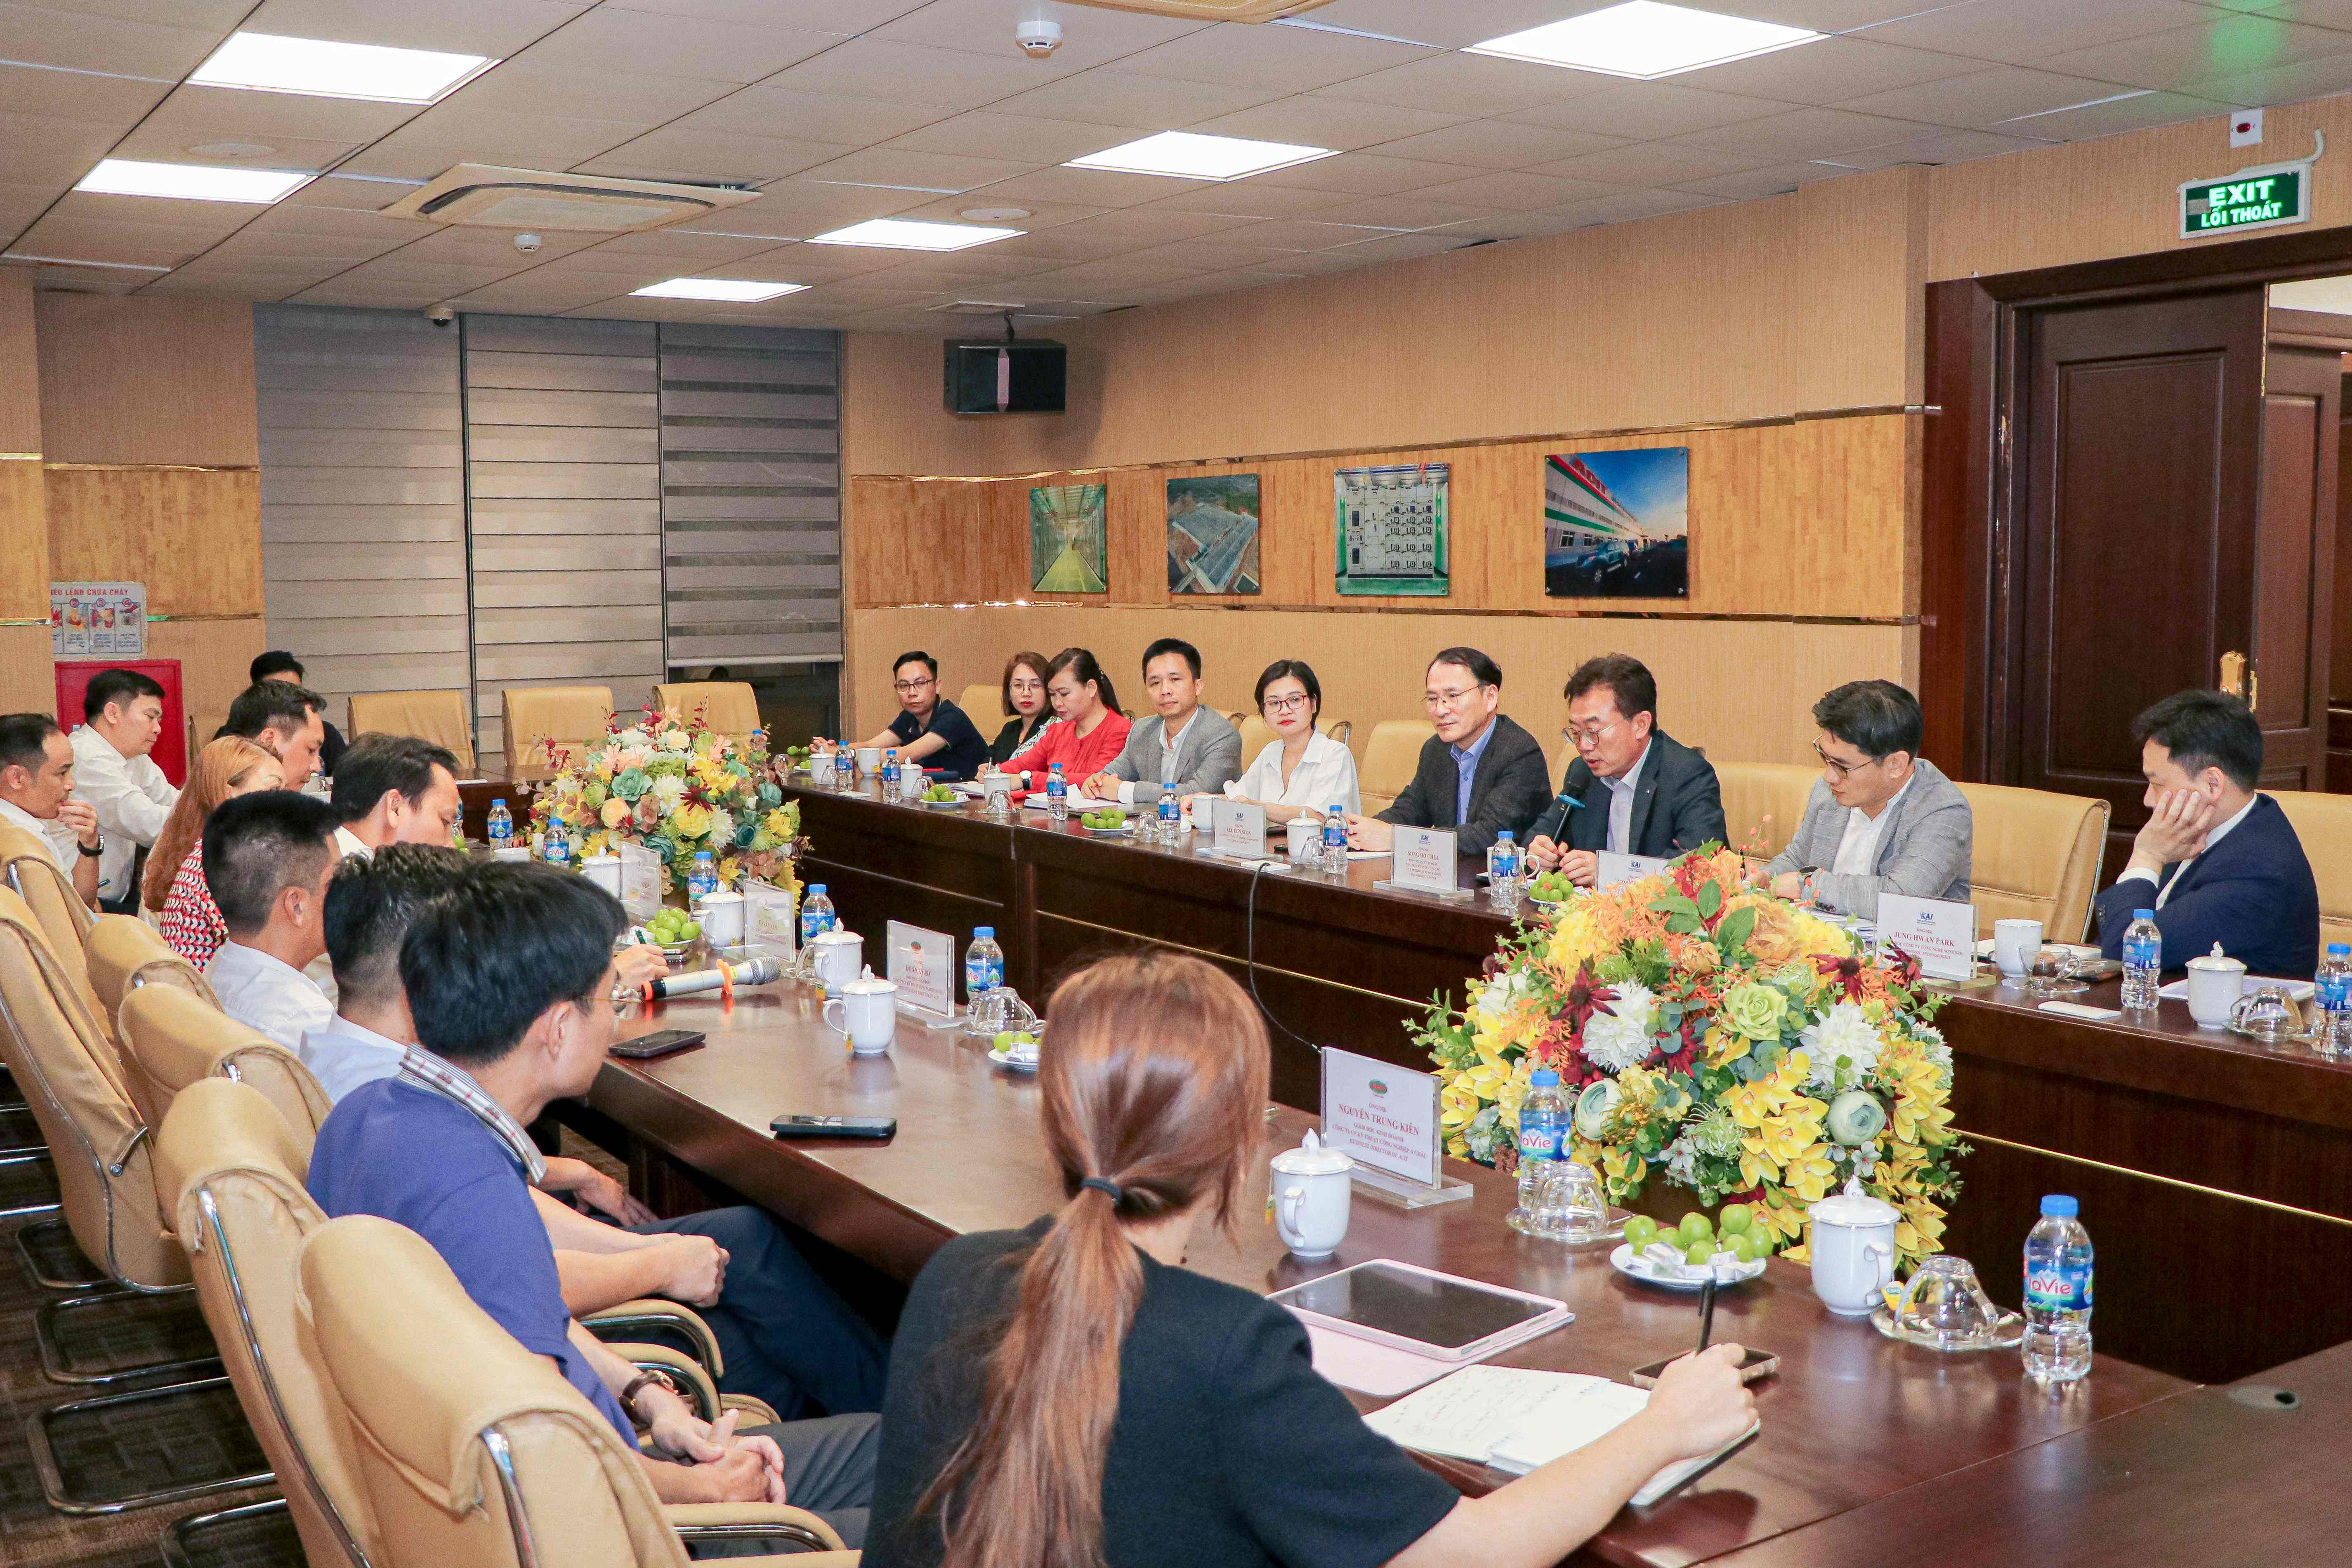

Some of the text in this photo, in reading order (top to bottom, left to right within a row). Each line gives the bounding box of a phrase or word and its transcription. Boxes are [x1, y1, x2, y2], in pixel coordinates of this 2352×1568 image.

[2209, 179, 2275, 207] EXIT
[2201, 200, 2282, 227] LỐI THOÁT
[1894, 931, 1954, 947] JUNG HWAN PARK
[1372, 1113, 1400, 1129] TRUNG
[1400, 1122, 1419, 1136] KIÊN
[1521, 1135, 1552, 1148] aVie
[2029, 1275, 2071, 1294] laVie
